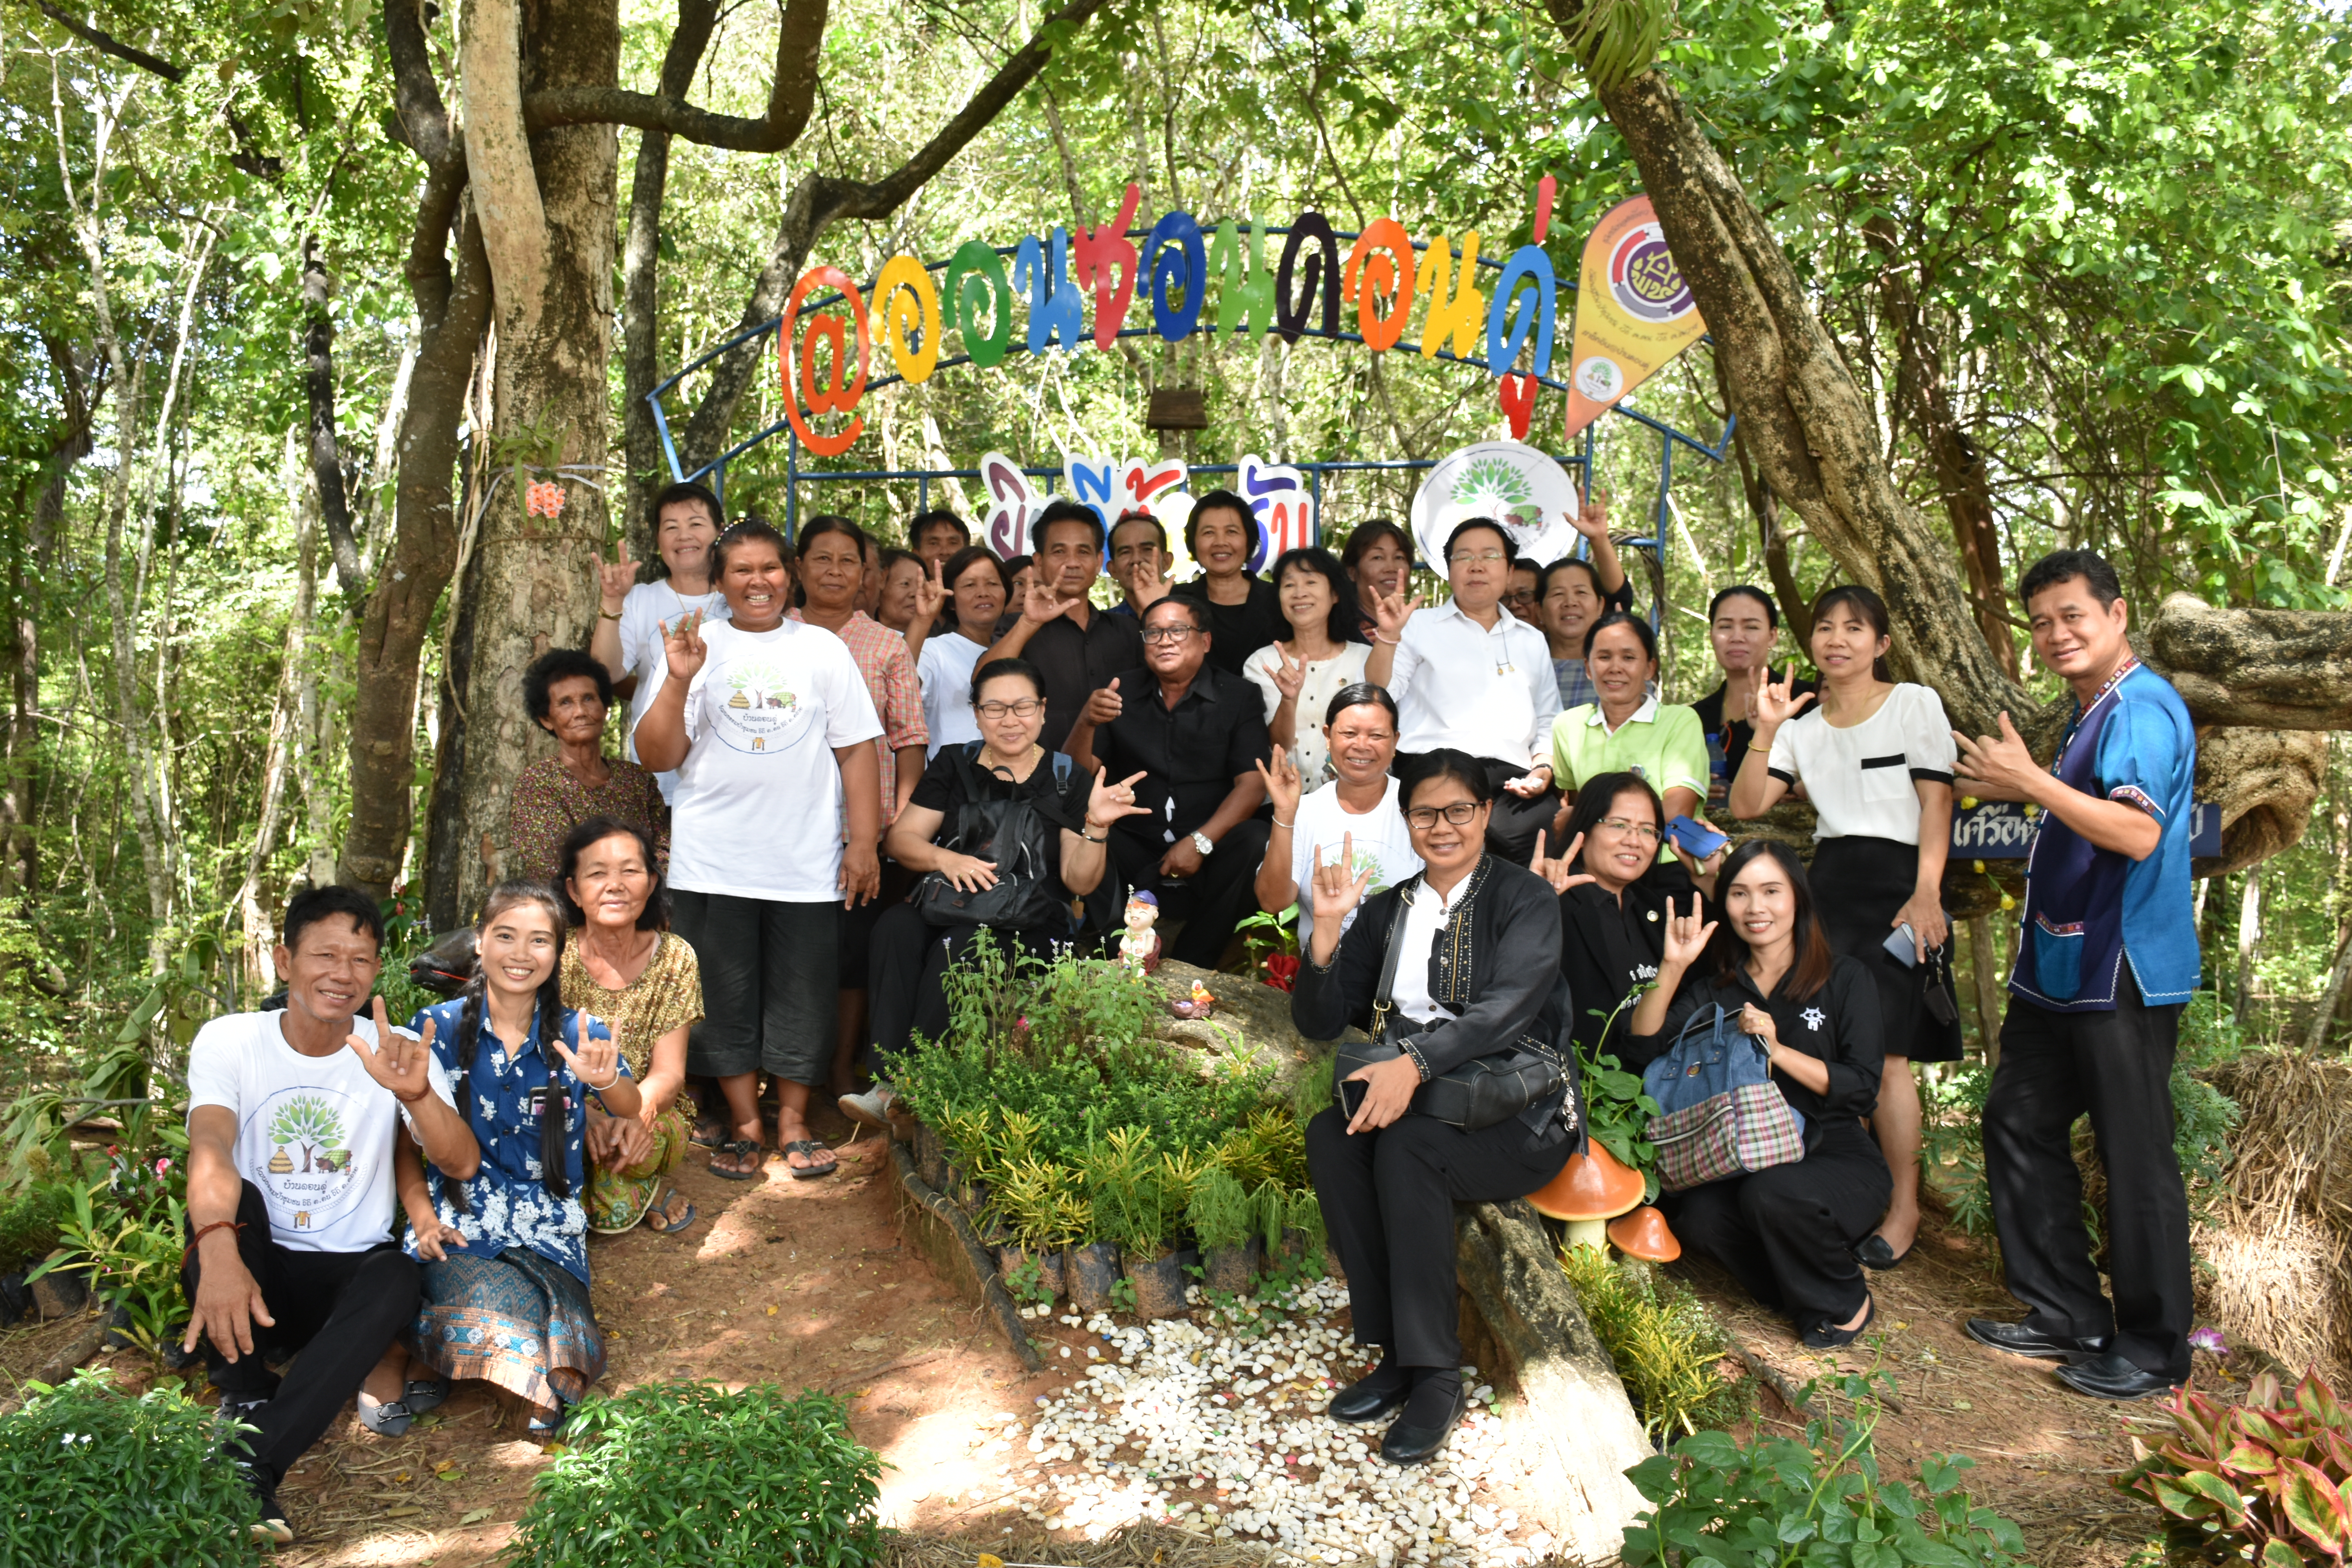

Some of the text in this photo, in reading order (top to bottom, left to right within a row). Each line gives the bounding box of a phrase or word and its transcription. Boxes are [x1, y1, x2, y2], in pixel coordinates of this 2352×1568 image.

[743, 713, 777, 725] บ้านดอนดู่
[283, 1179, 327, 1194] บ้านดอนดู่
